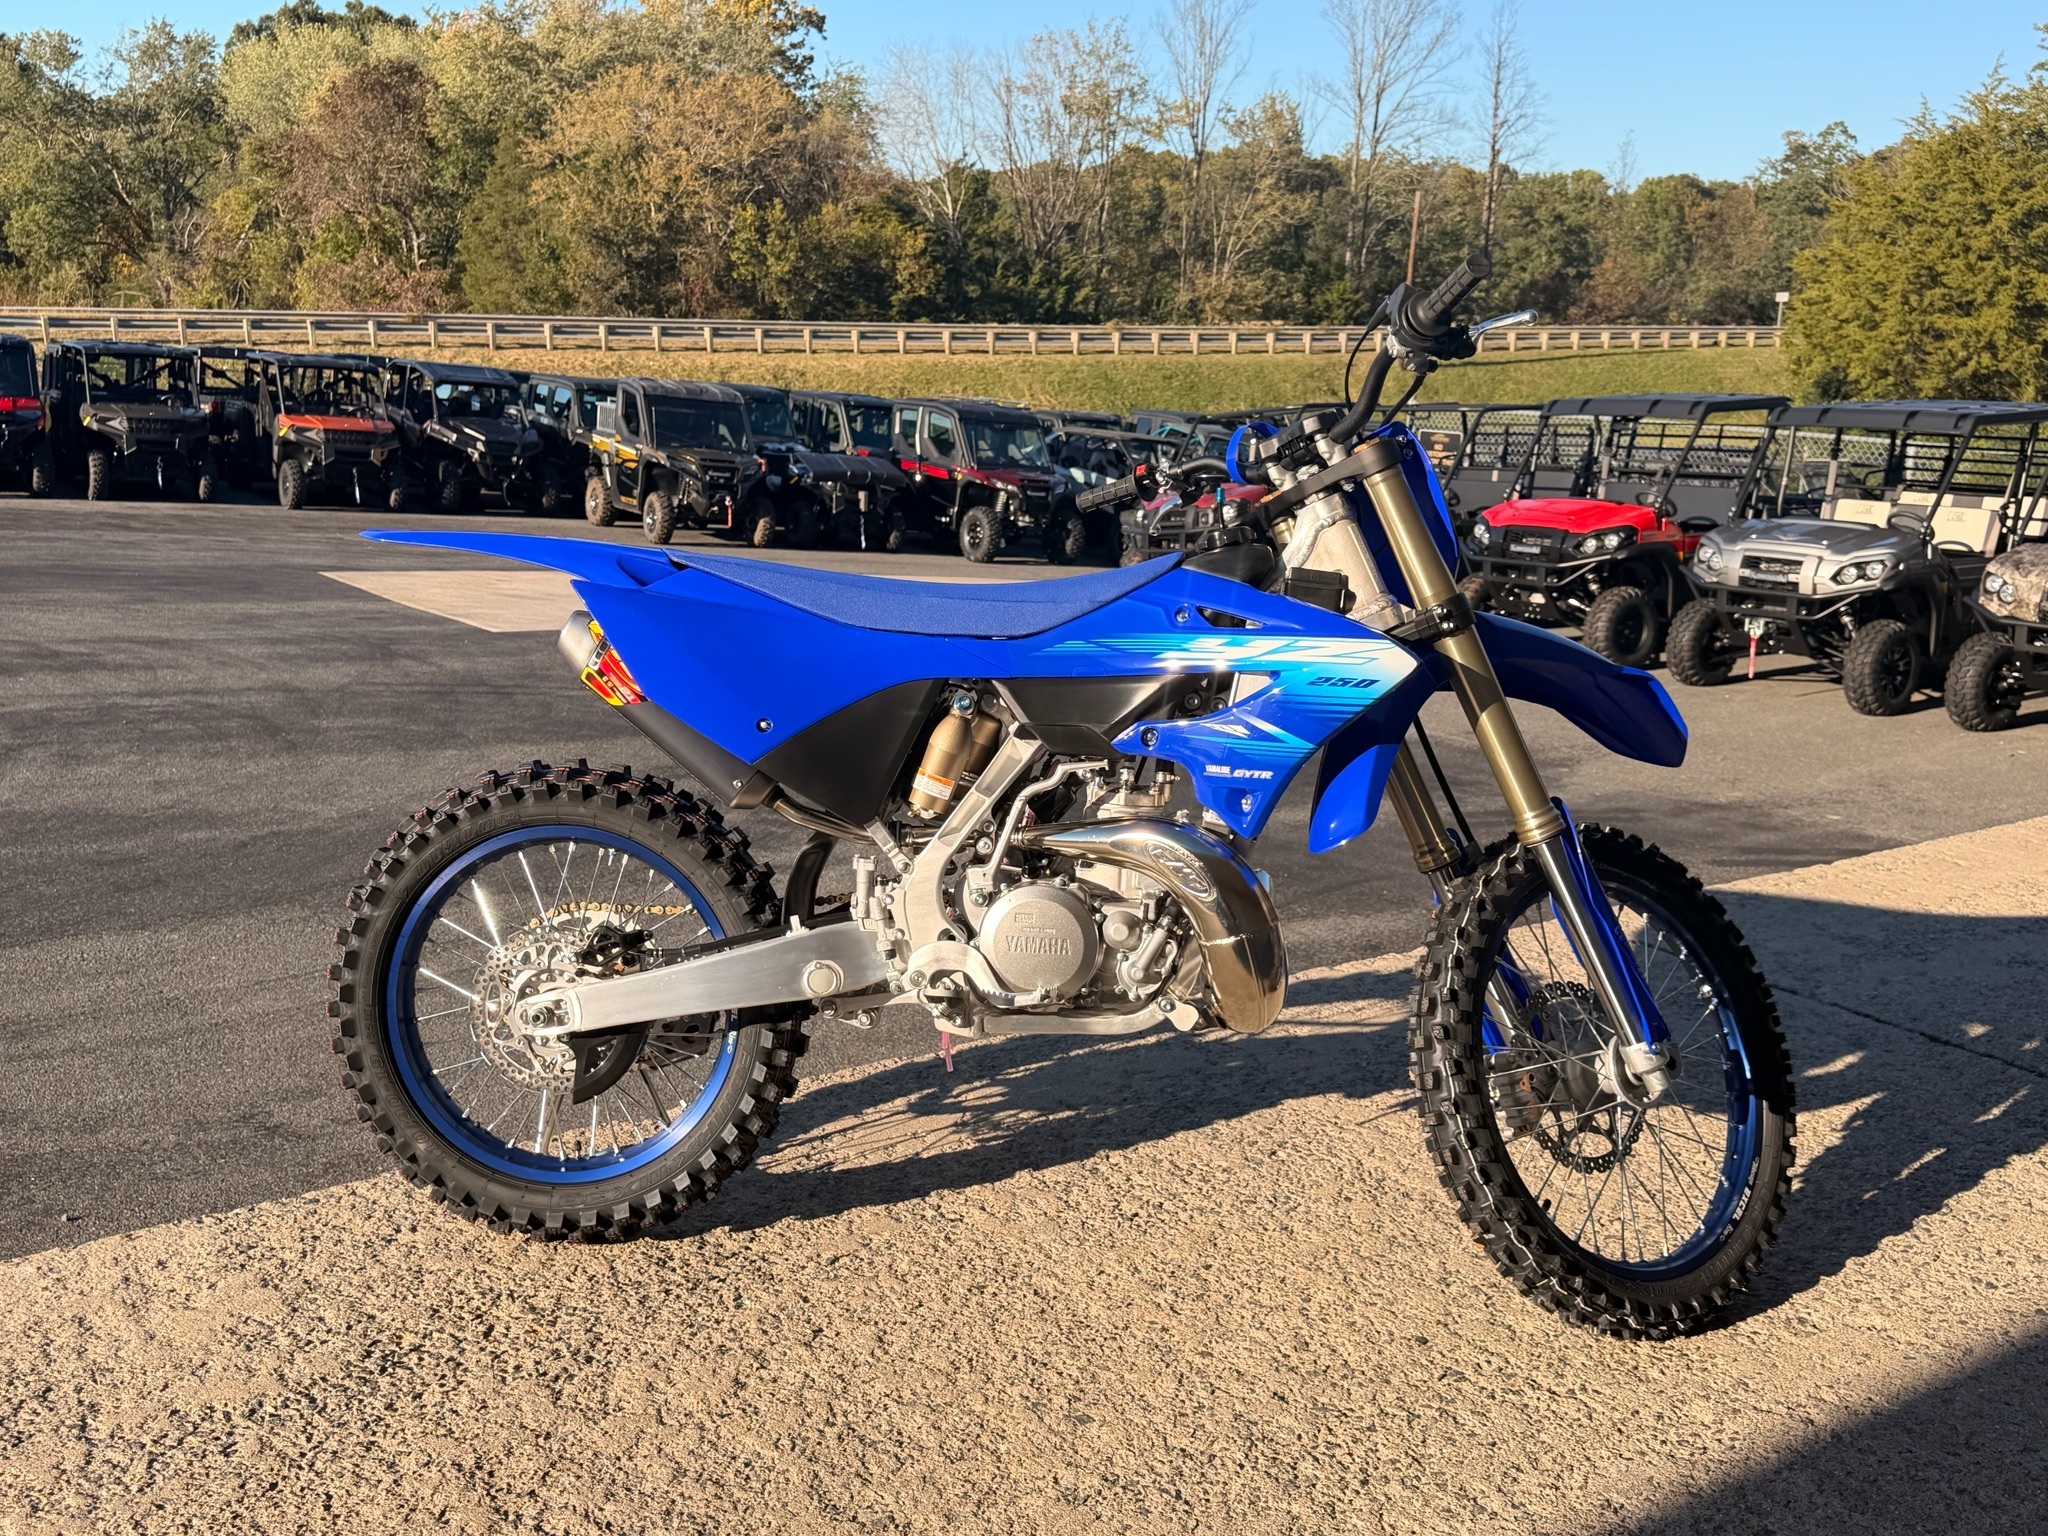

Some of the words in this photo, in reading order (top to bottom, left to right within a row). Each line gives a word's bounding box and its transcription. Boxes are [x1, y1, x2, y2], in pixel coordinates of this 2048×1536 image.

[1155, 637, 1393, 665] YZ
[1305, 676, 1381, 689] 250
[1232, 769, 1274, 779] GYTR
[414, 810, 517, 879] DUNLOP
[1005, 935, 1071, 956] YAMAHA
[1732, 1186, 1752, 1221] EXCEL
